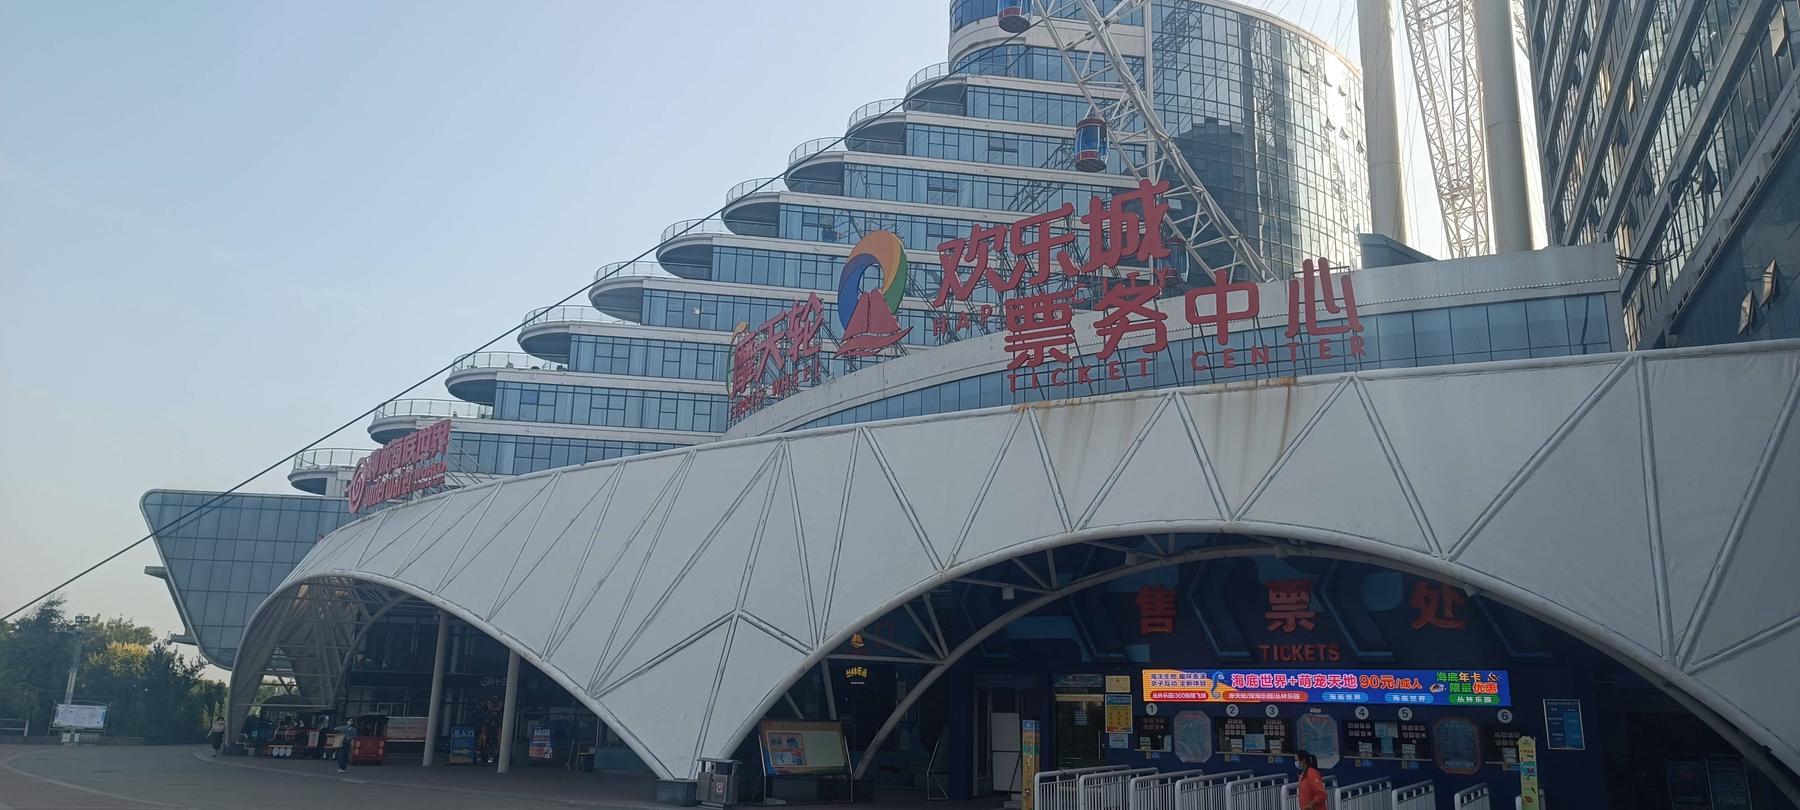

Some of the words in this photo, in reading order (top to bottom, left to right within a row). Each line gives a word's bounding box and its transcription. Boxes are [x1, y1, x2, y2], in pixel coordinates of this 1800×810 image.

[933, 178, 1171, 308] 欢乐城
[1004, 257, 1365, 371] 票务中心
[731, 291, 824, 401] 摩天轮
[1006, 356, 1151, 393] TICKET
[1190, 335, 1366, 372] CENTER
[1136, 580, 1468, 635] 售票处
[1259, 643, 1340, 662] TICKETS
[1436, 672, 1482, 682] 海底年卡
[1231, 673, 1358, 689] 海底世界+萌宠天地
[1359, 674, 1422, 690] 90元/成人
